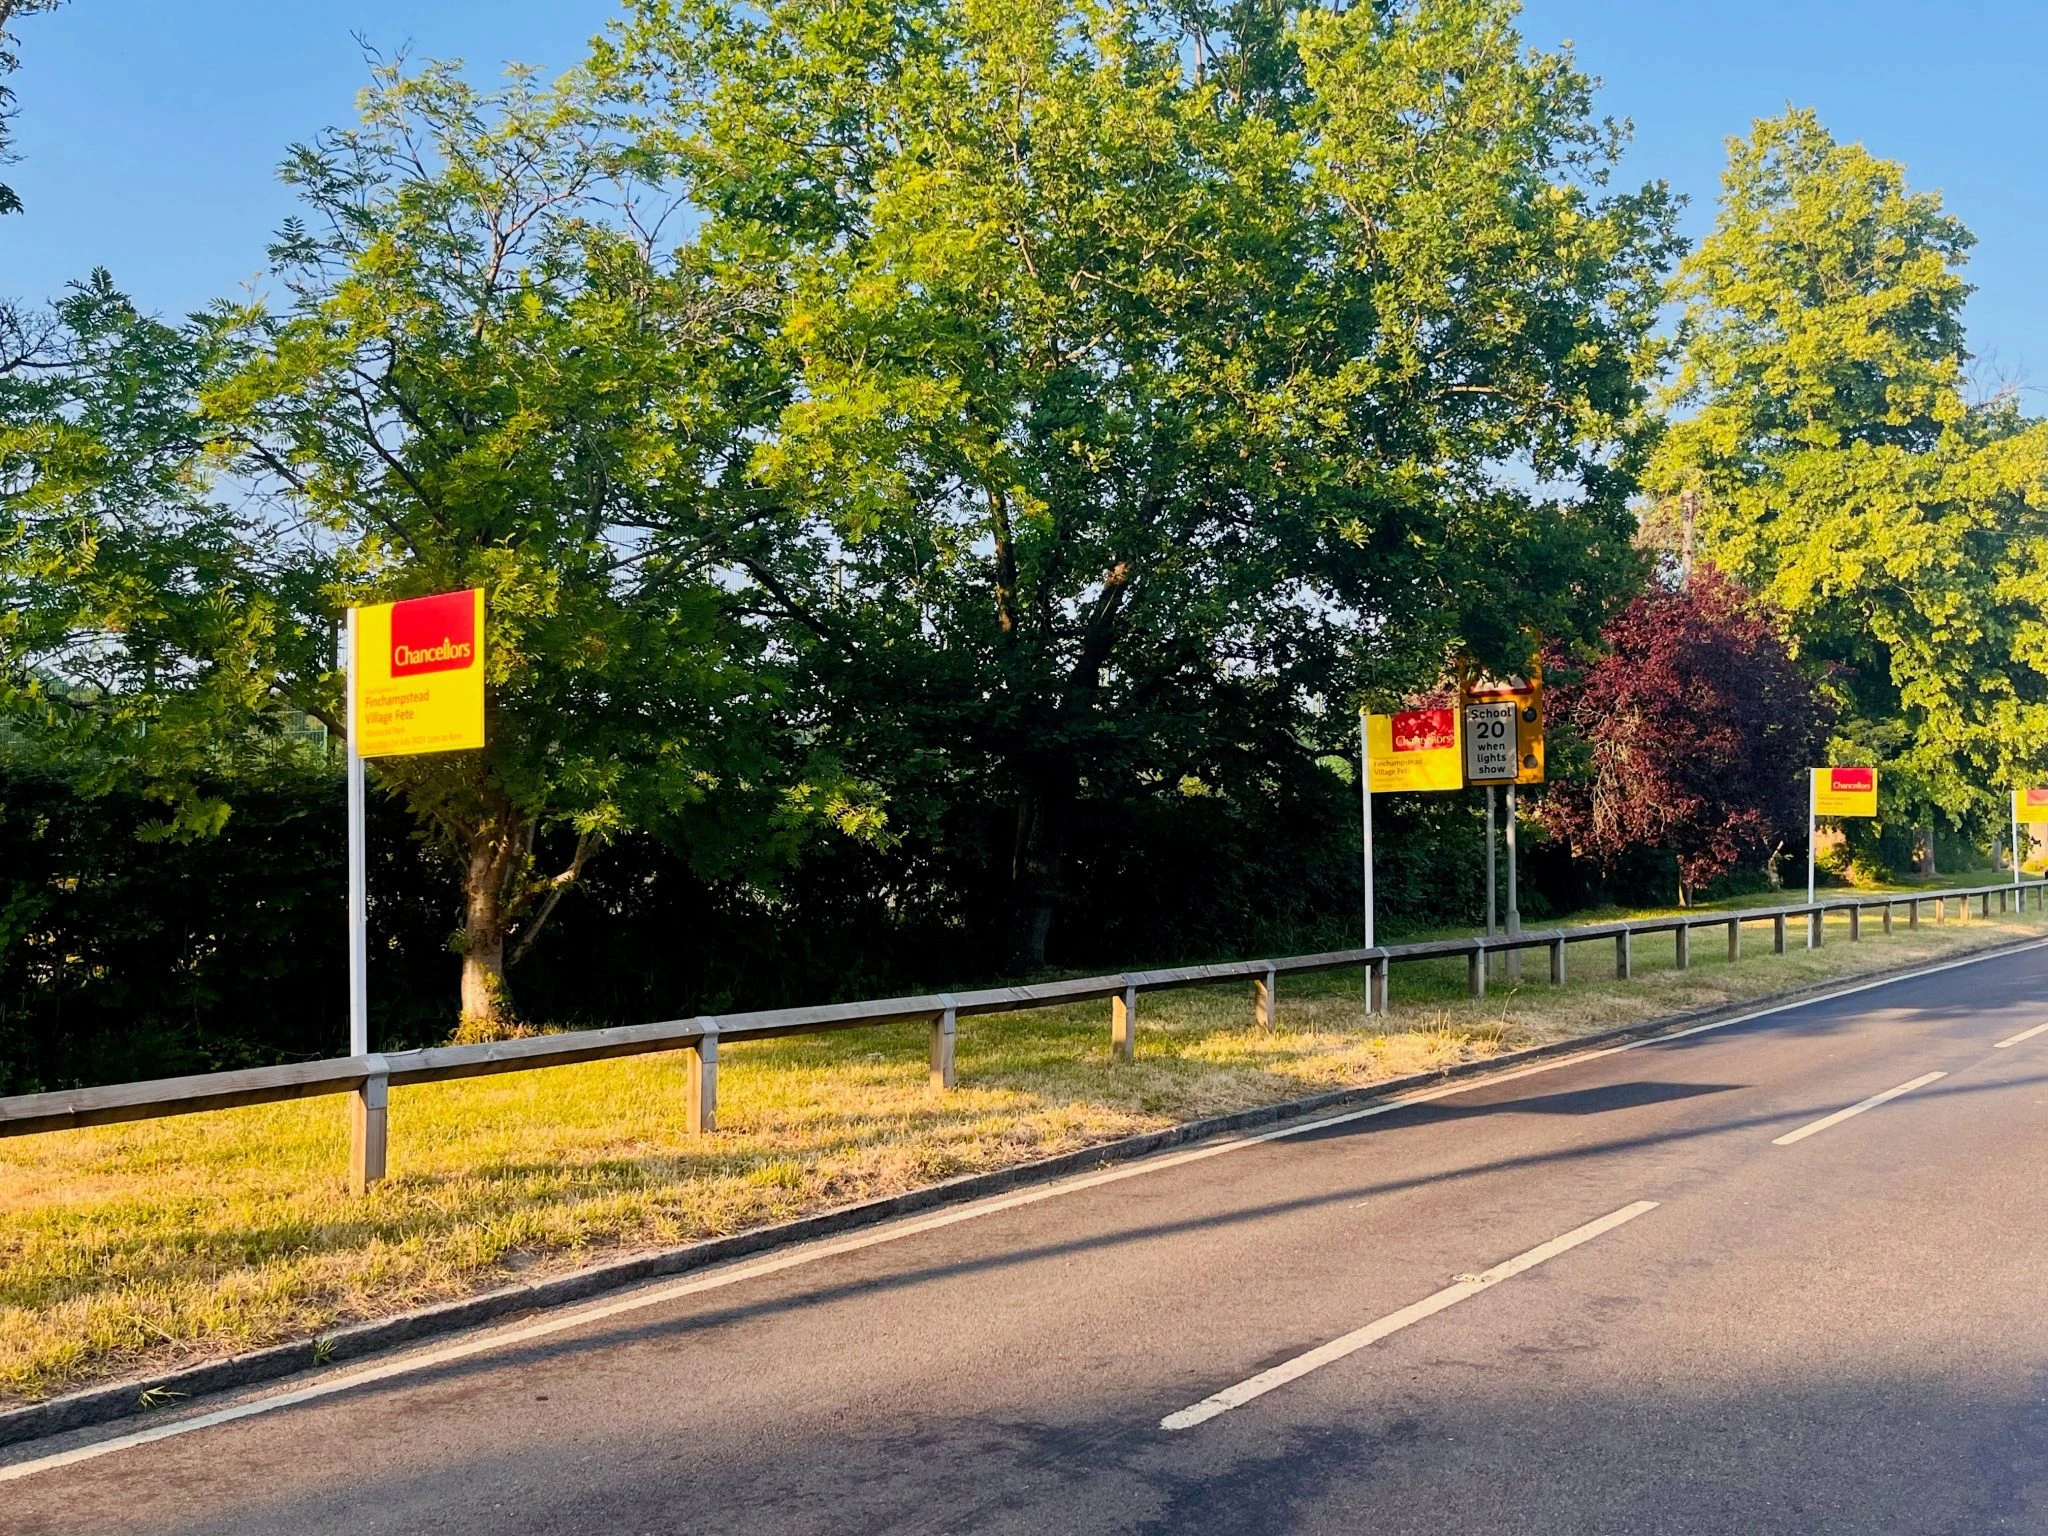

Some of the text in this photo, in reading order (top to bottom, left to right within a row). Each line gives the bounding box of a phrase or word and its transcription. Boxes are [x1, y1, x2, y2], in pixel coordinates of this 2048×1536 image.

[394, 638, 471, 667] Chancellors
[365, 688, 430, 708] Finchampstead
[365, 709, 414, 725] Village Fete
[1471, 707, 1512, 719] School
[1476, 721, 1505, 739] 20
[1477, 742, 1505, 751] when
[1477, 753, 1506, 764] lights
[1479, 765, 1505, 774] show
